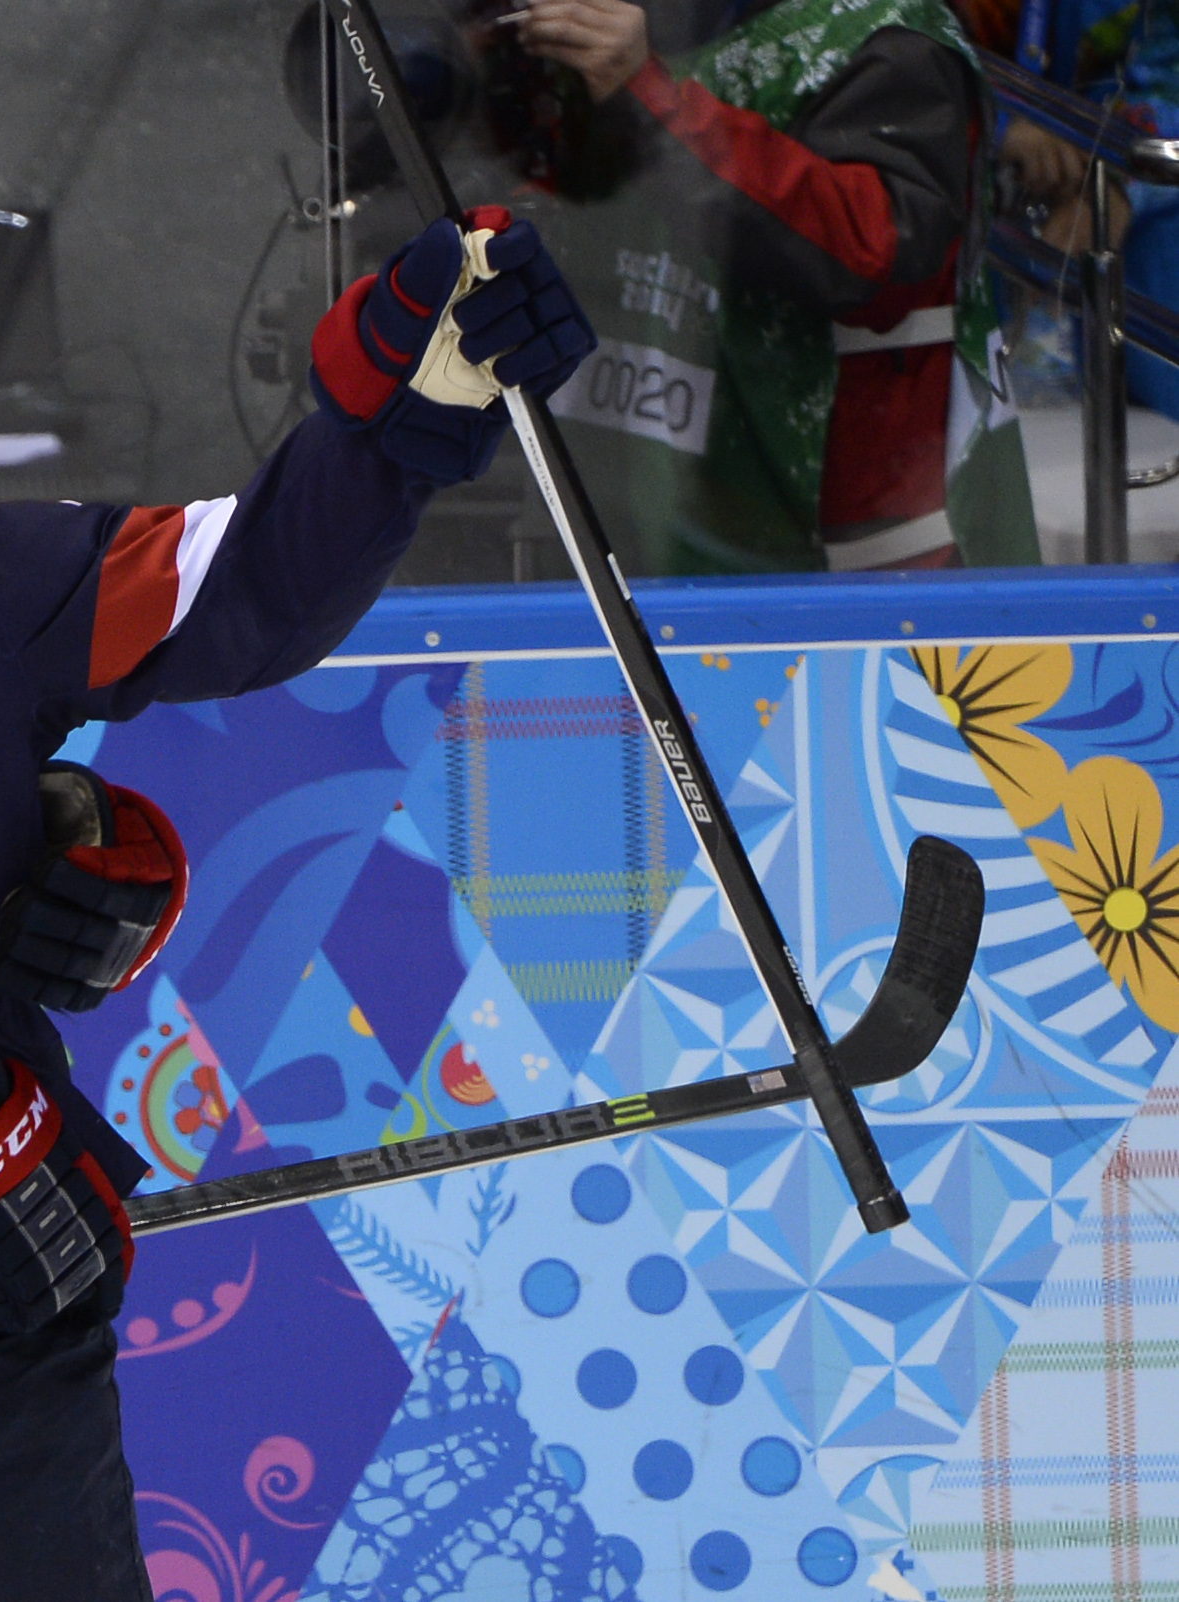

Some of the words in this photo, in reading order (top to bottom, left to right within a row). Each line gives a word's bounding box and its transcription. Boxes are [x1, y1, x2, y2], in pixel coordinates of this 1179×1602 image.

[341, 10, 385, 109] VAPOR
[588, 355, 695, 433] 0020
[653, 719, 712, 823] BAUER
